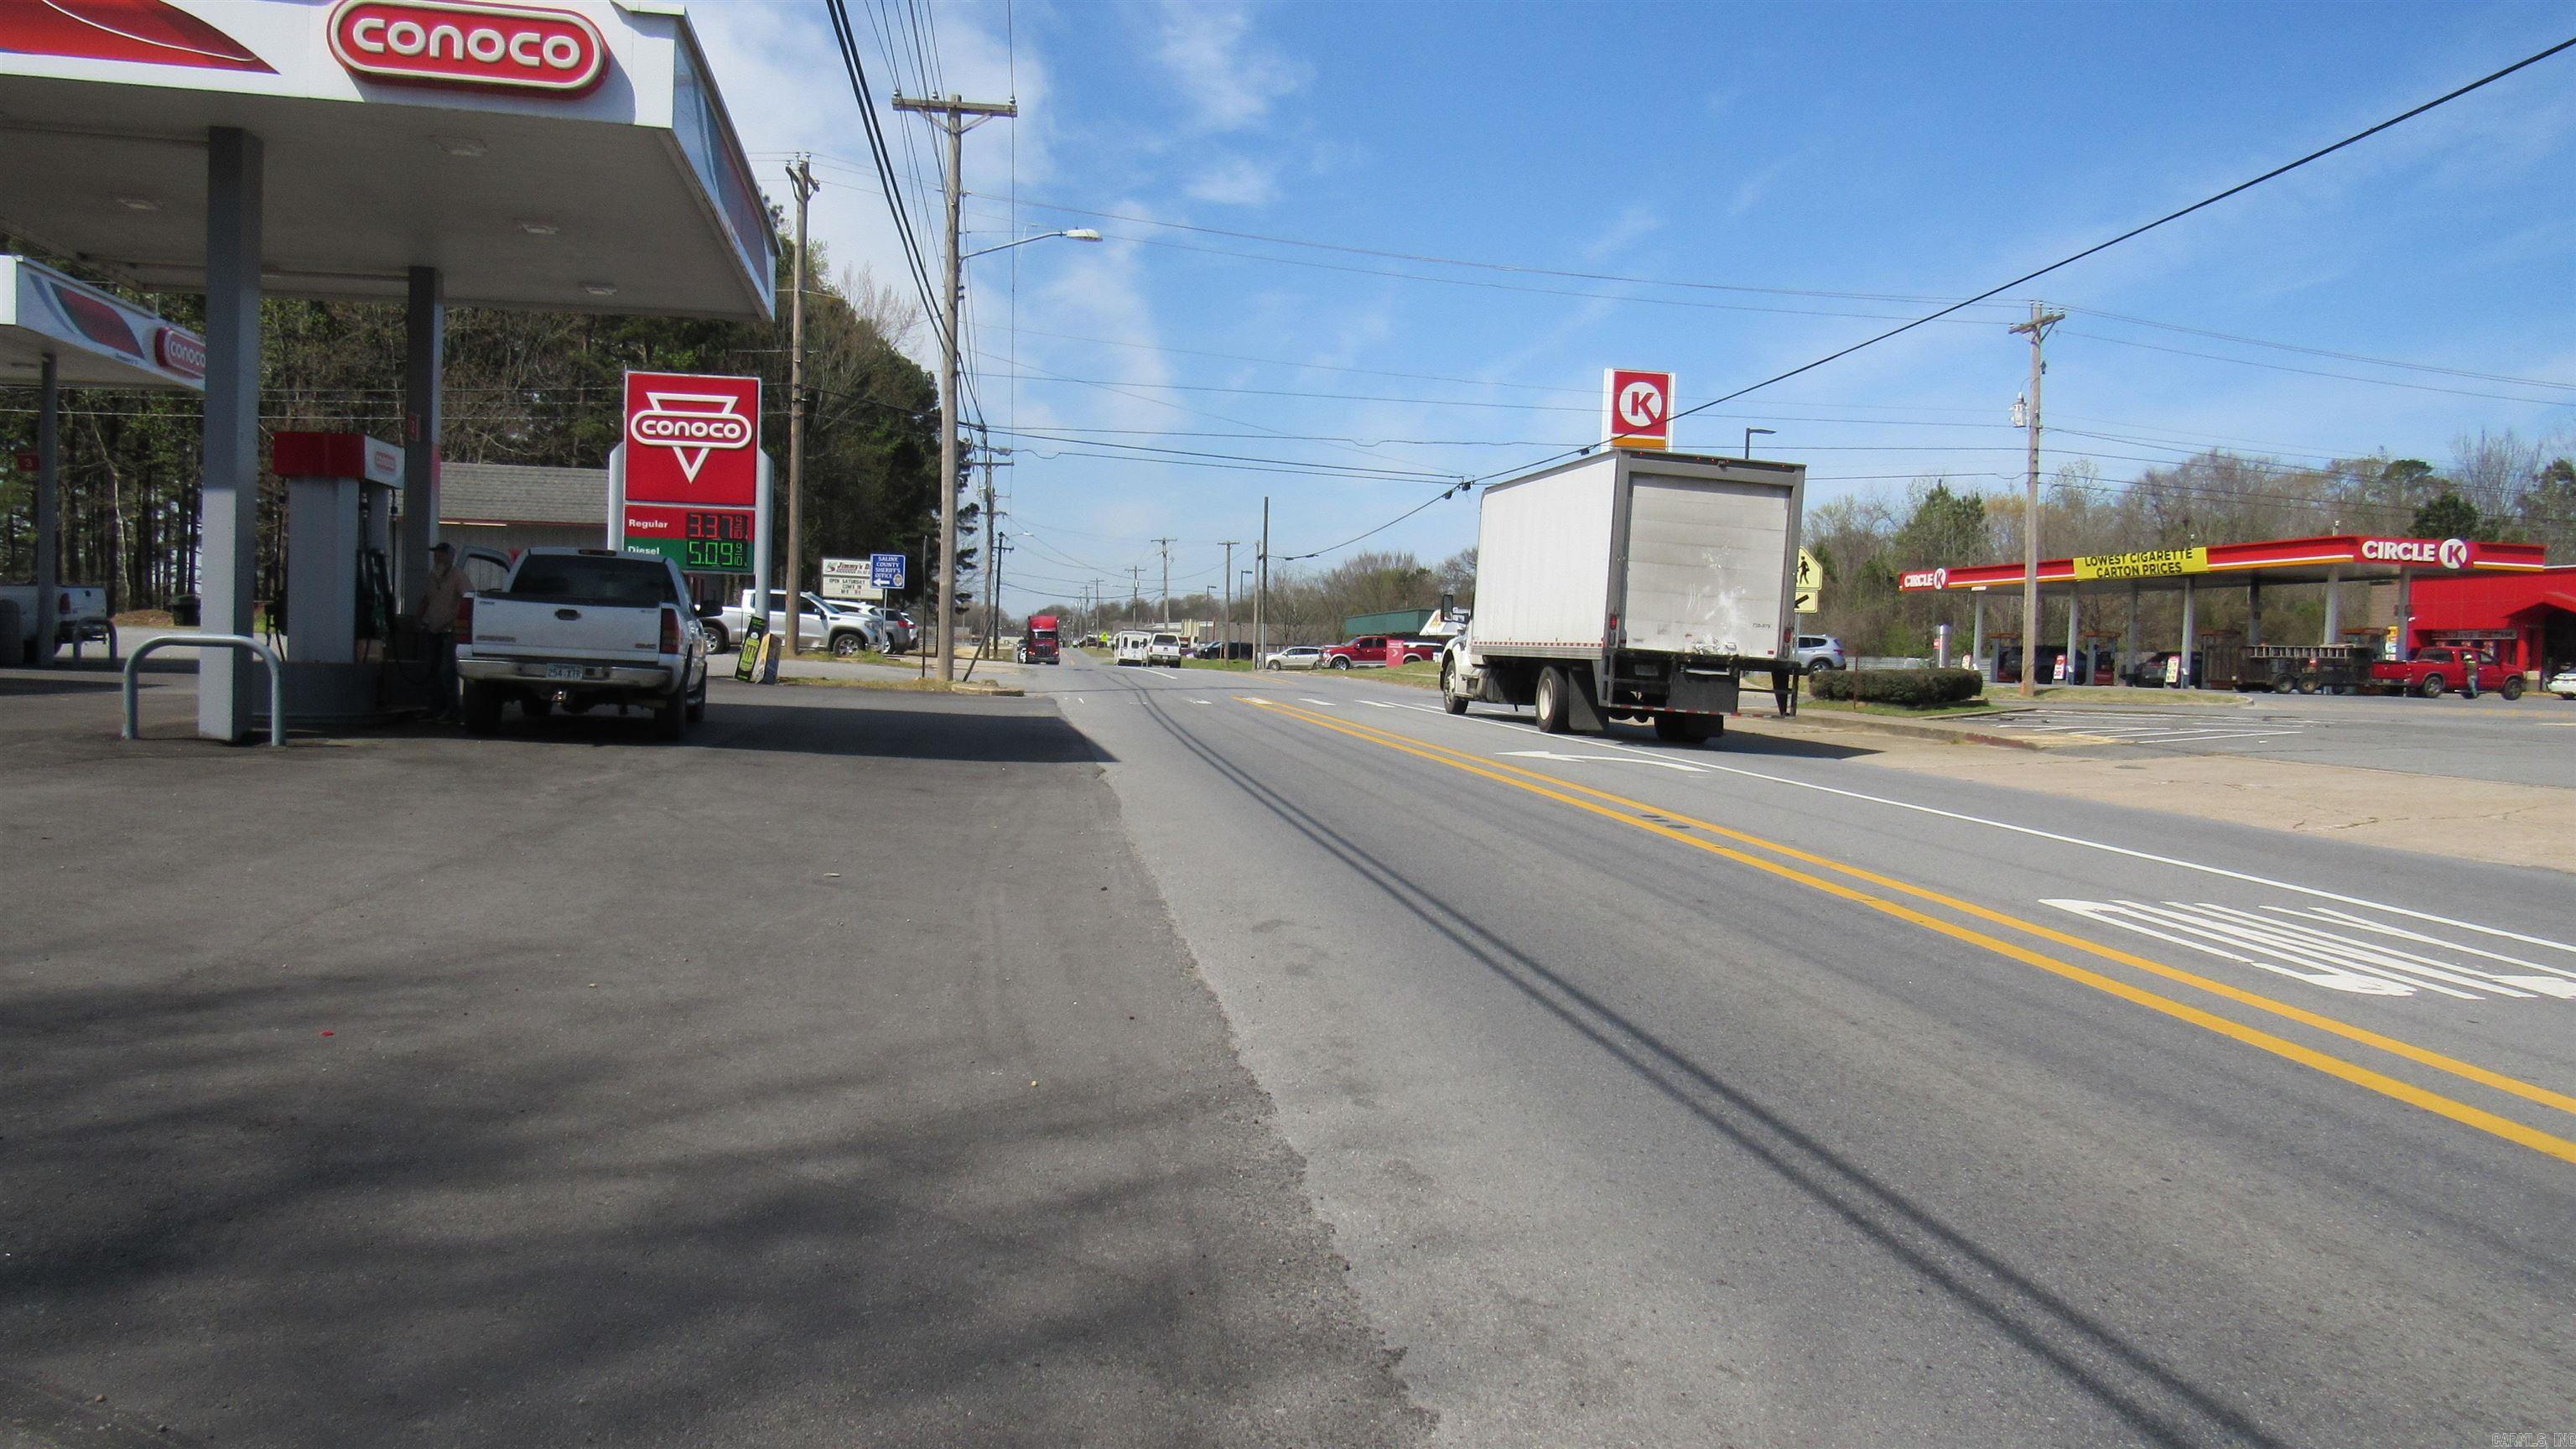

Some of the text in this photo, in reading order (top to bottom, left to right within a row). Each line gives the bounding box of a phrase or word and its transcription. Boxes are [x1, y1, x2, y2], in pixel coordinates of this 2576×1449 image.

[628, 518, 668, 529] Regular
[628, 545, 660, 555] Diesel
[2085, 548, 2194, 567] LOWEST CIGARETTE
[2361, 540, 2435, 562] CIRCLE
[2096, 562, 2182, 578] CARTON PRICES
[1903, 574, 1934, 588] CIRCLE
